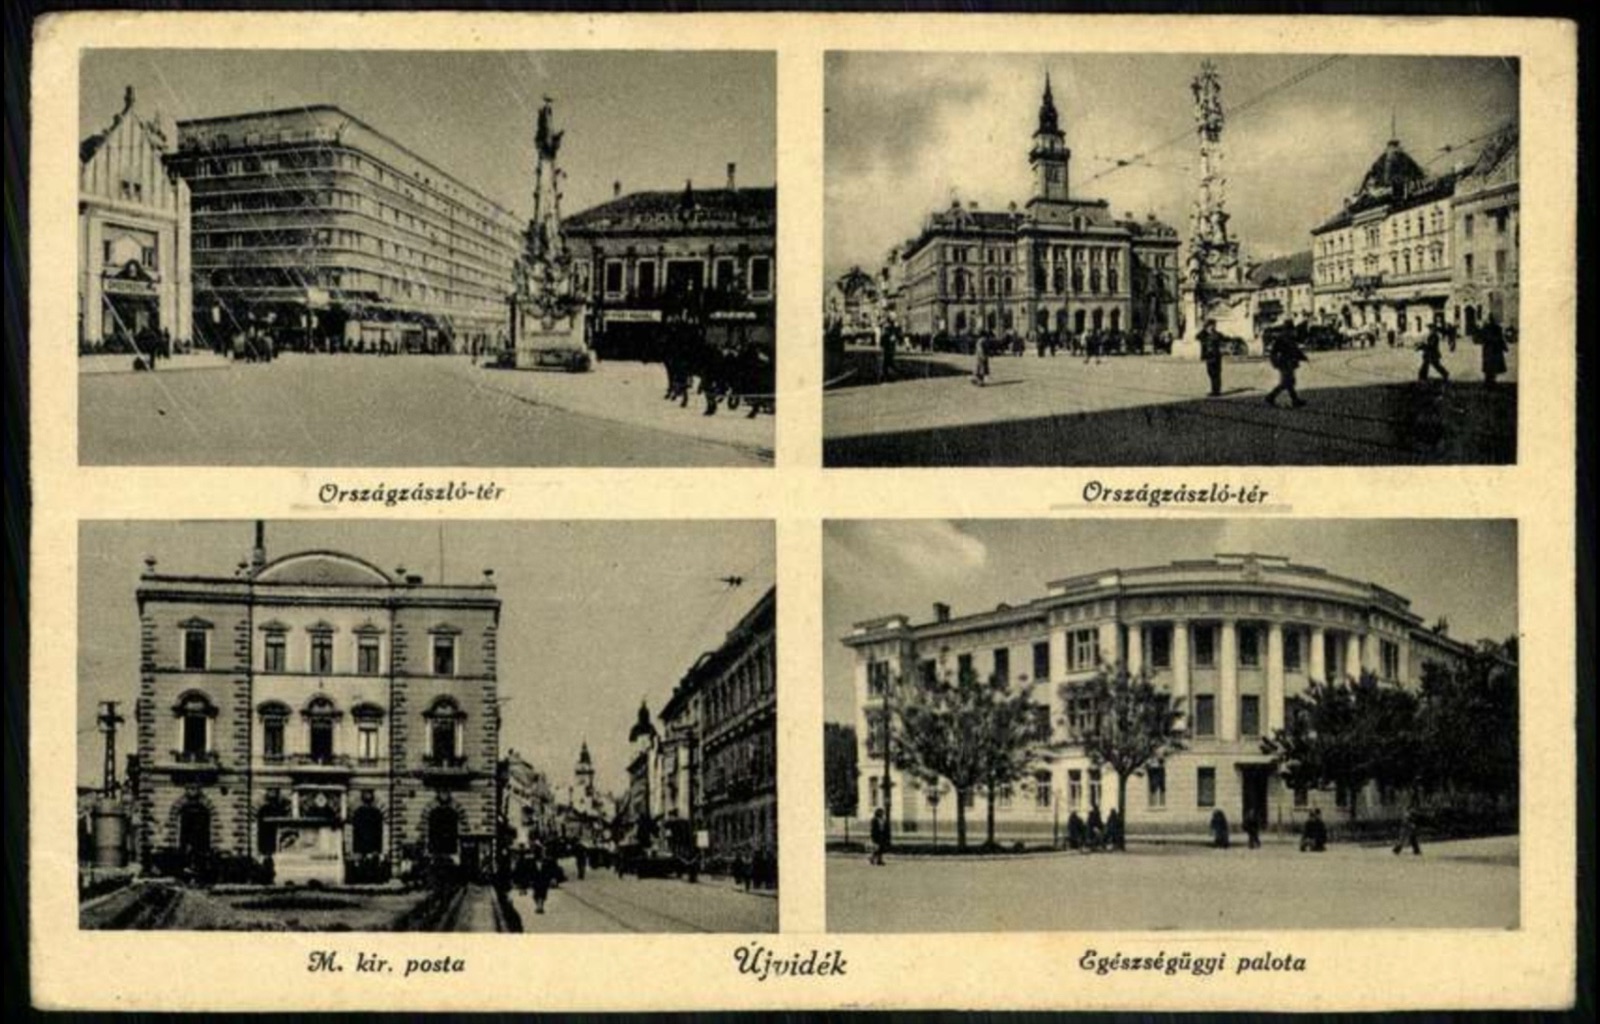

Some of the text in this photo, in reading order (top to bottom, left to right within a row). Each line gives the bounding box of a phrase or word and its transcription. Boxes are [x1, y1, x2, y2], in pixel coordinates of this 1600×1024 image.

[318, 482, 504, 507] Országzászló-tér
[1082, 480, 1269, 507] Országzászló-tér
[307, 951, 466, 977] M. kir. posta
[734, 941, 848, 981] Újvidék
[1079, 950, 1307, 976] Egészségügyi palota
